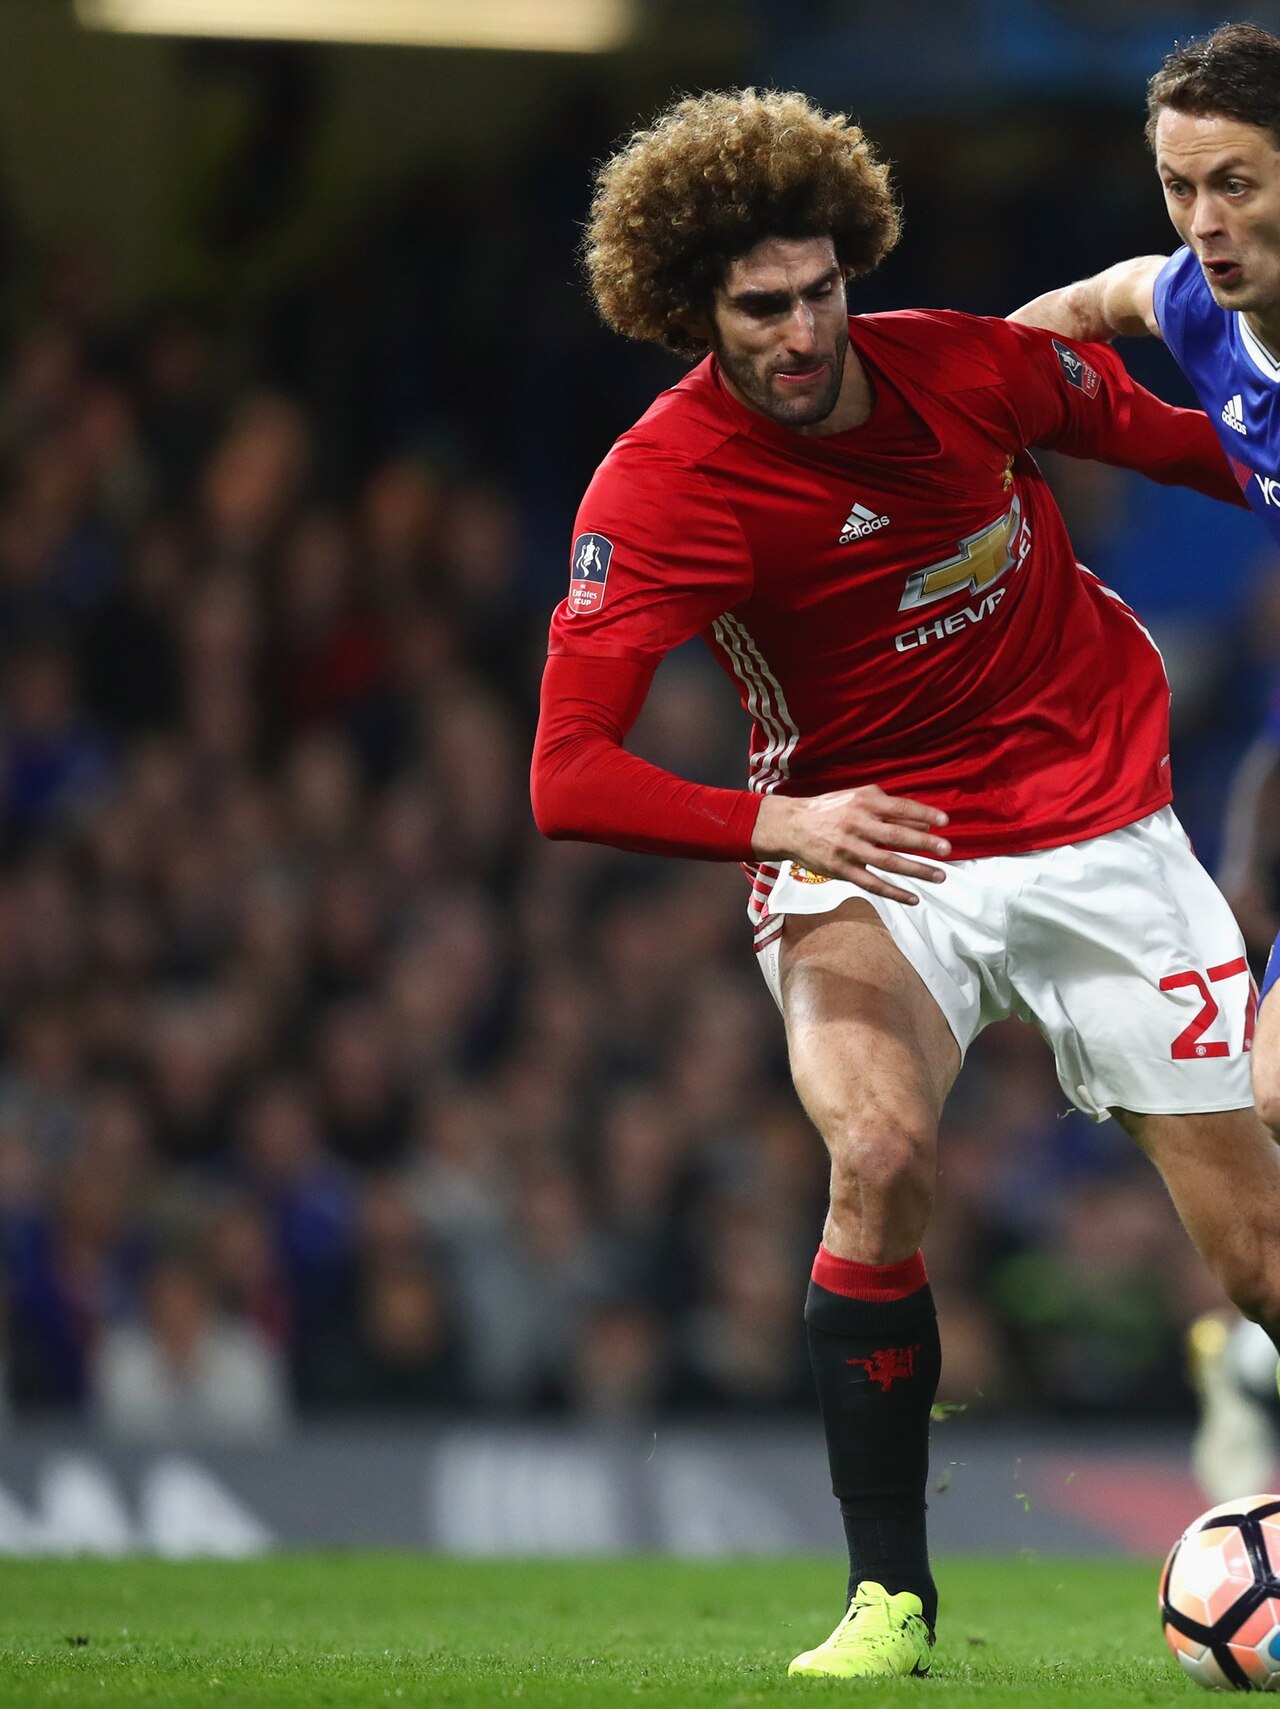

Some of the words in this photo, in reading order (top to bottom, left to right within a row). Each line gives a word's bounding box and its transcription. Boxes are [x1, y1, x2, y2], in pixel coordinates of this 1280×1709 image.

[1221, 410, 1247, 436] adidas
[839, 515, 890, 544] adidas
[1159, 956, 1259, 1060] 27
